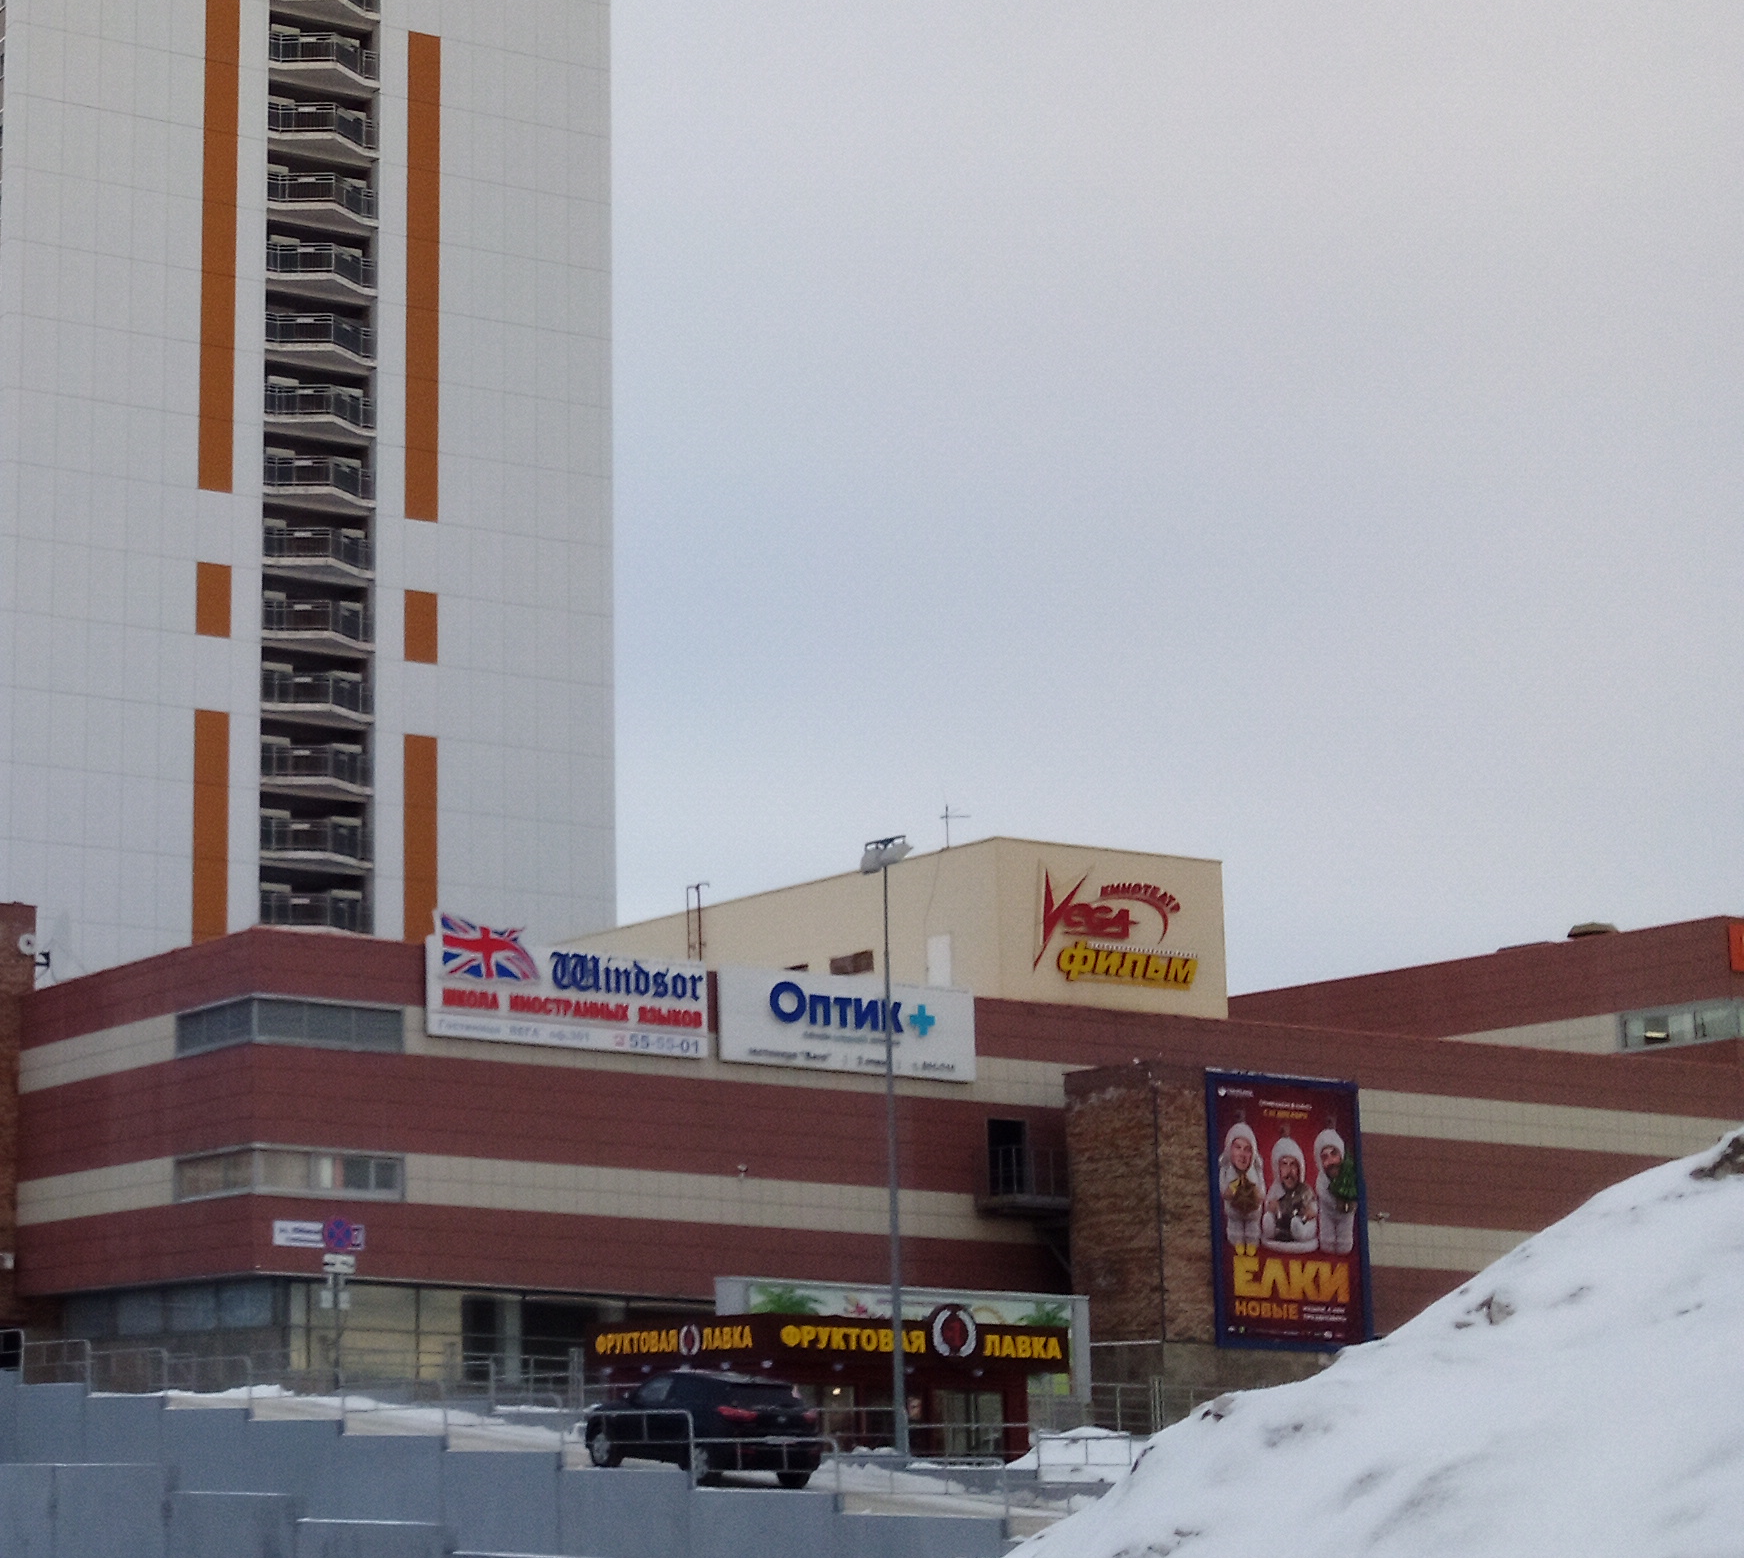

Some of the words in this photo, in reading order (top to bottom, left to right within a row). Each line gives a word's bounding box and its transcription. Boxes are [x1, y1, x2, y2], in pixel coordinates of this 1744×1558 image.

[1099, 882, 1182, 915] КИНОТЕАТР
[550, 951, 704, 1002] Windsor
[442, 988, 500, 1011] ШКОЛА
[509, 993, 629, 1022] ИНОСТРАННЫХ
[638, 1005, 703, 1029] ЯЗЫКОВ
[1233, 1243, 1350, 1303] ЁЛКИ
[1235, 1300, 1299, 1320] НОВЫЕ
[595, 1329, 678, 1355] ФРУКТОВАЯ
[702, 1325, 753, 1350] ЛАВКА
[983, 1334, 1062, 1360] ЛАВКА
